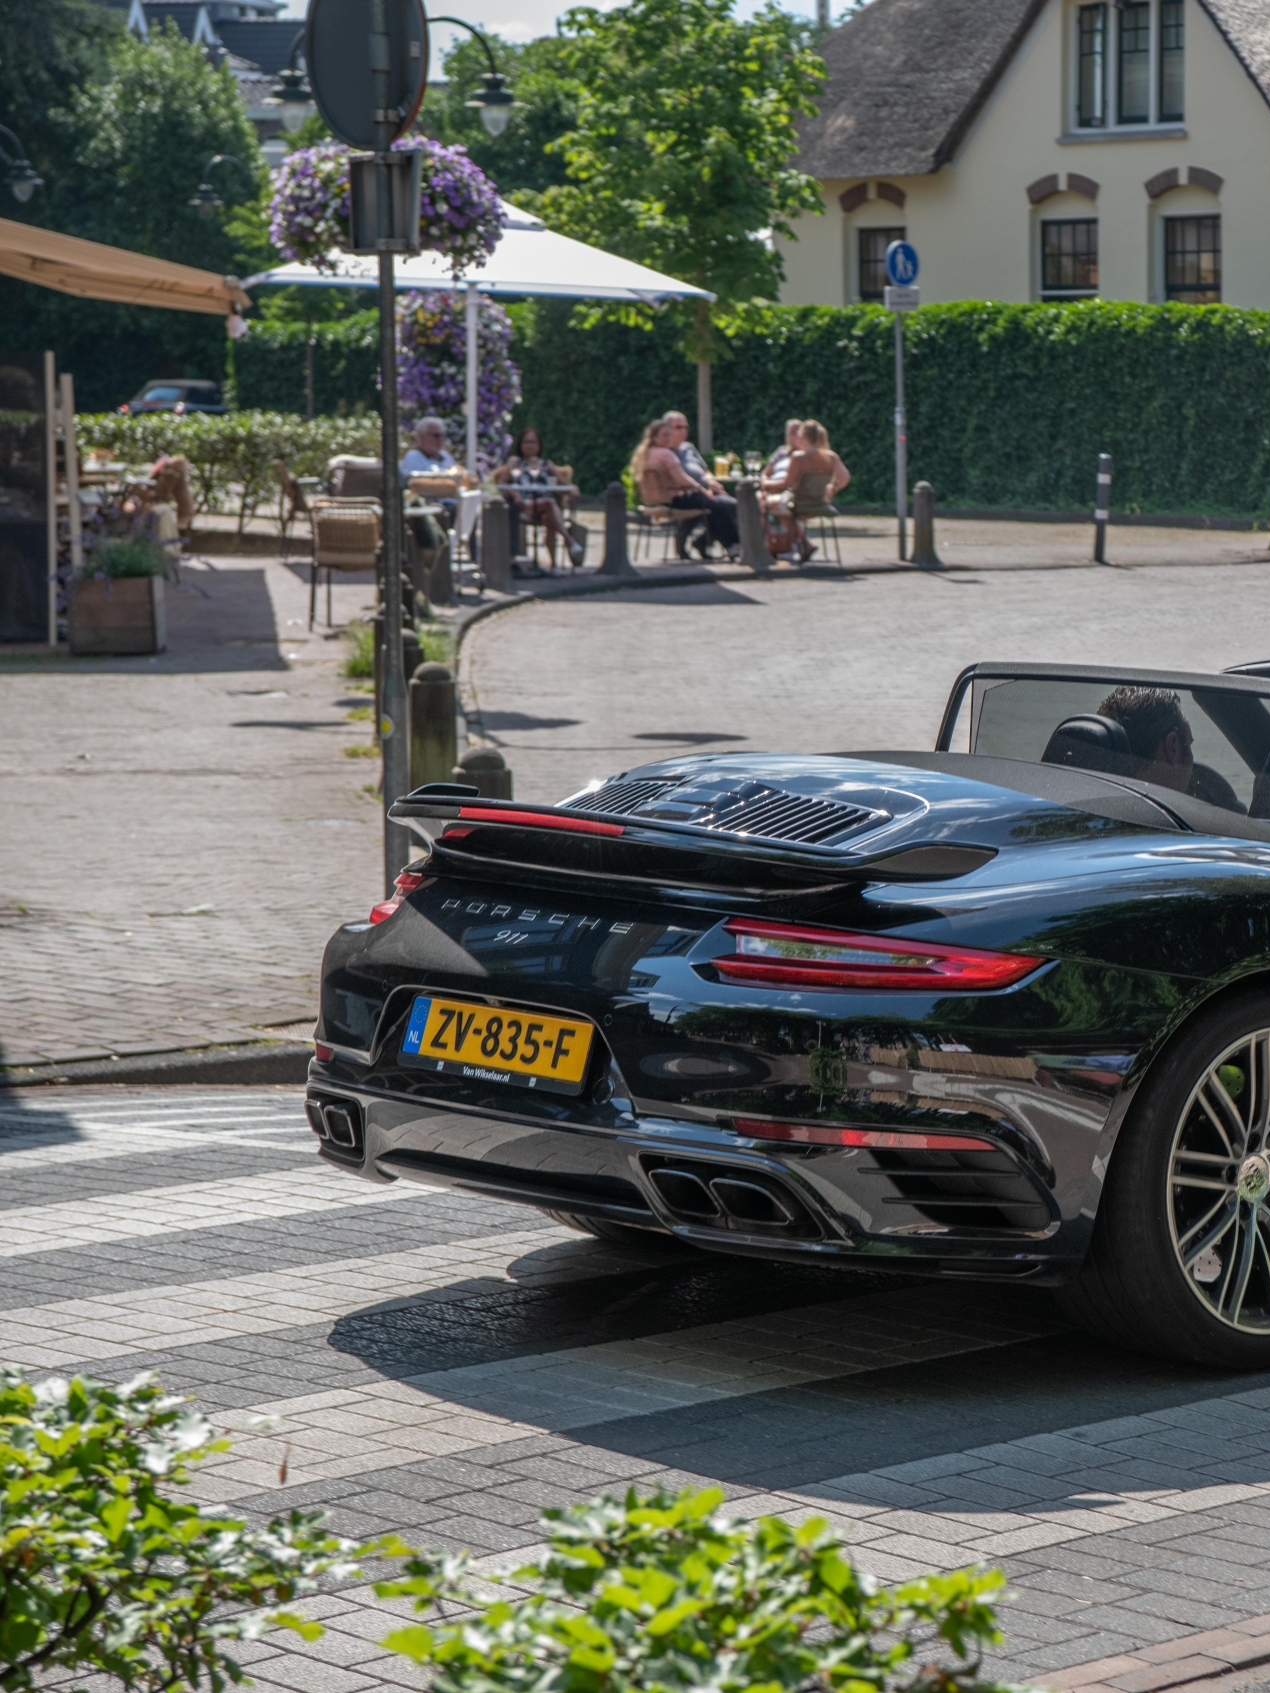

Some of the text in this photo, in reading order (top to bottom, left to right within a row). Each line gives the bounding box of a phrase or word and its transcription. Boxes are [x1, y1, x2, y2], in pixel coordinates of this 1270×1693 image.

[441, 899, 634, 935] PORSCHE
[494, 930, 529, 945] 911
[408, 1008, 576, 1070] NL ZV-835-F
[463, 1066, 511, 1082] Van Wikselaar.nl
